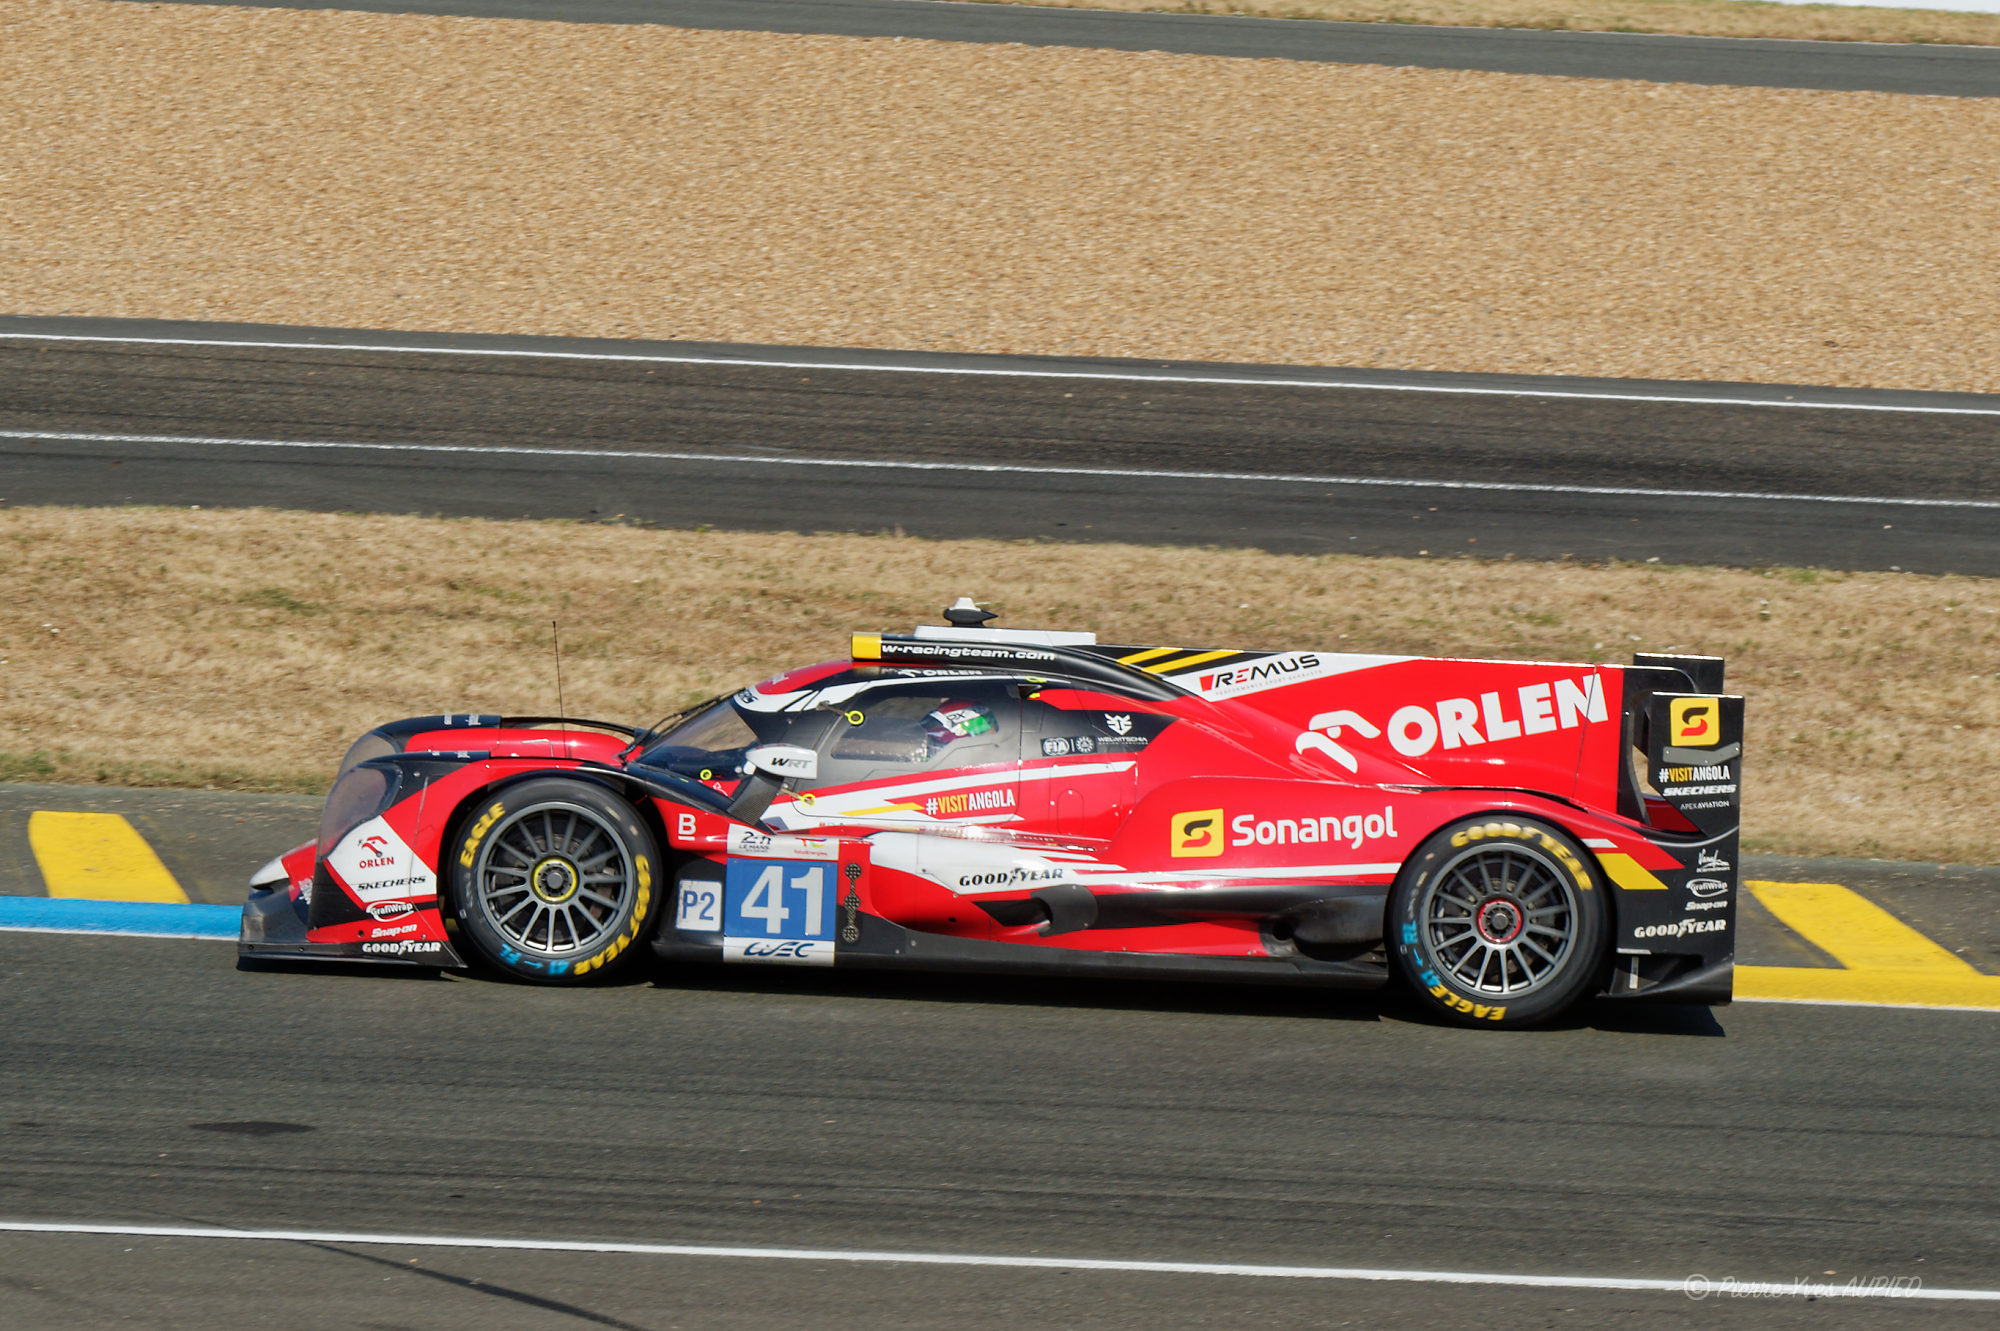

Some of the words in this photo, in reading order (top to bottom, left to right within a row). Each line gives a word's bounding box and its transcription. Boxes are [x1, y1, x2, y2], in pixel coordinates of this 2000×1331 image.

[881, 645, 1056, 660] w-racingteam.com
[1215, 654, 1320, 688] REMUS
[1387, 673, 1609, 757] ORLEN
[1045, 740, 1069, 753] FIA
[771, 757, 812, 768] WRT
[1659, 765, 1731, 783] #VISITANGOLA
[1662, 784, 1737, 797] SKECHERS
[925, 788, 1016, 815] #VISITANGOLA
[678, 813, 696, 834] B
[1231, 805, 1398, 850] Sonangol
[459, 801, 507, 868] EAGLE
[359, 857, 395, 869] ORLEN
[358, 875, 427, 891] SKECHERS
[959, 867, 1064, 887] GOODYEAR
[682, 890, 716, 920] P2
[741, 865, 824, 936] 41
[1685, 901, 1728, 911] Snap-on
[371, 924, 418, 938] Snap-on
[1633, 918, 1727, 938] GOODYEAR
[362, 940, 442, 955] GOODYEAR
[743, 941, 815, 958] WEC
[1429, 984, 1507, 1020] EAGLE
